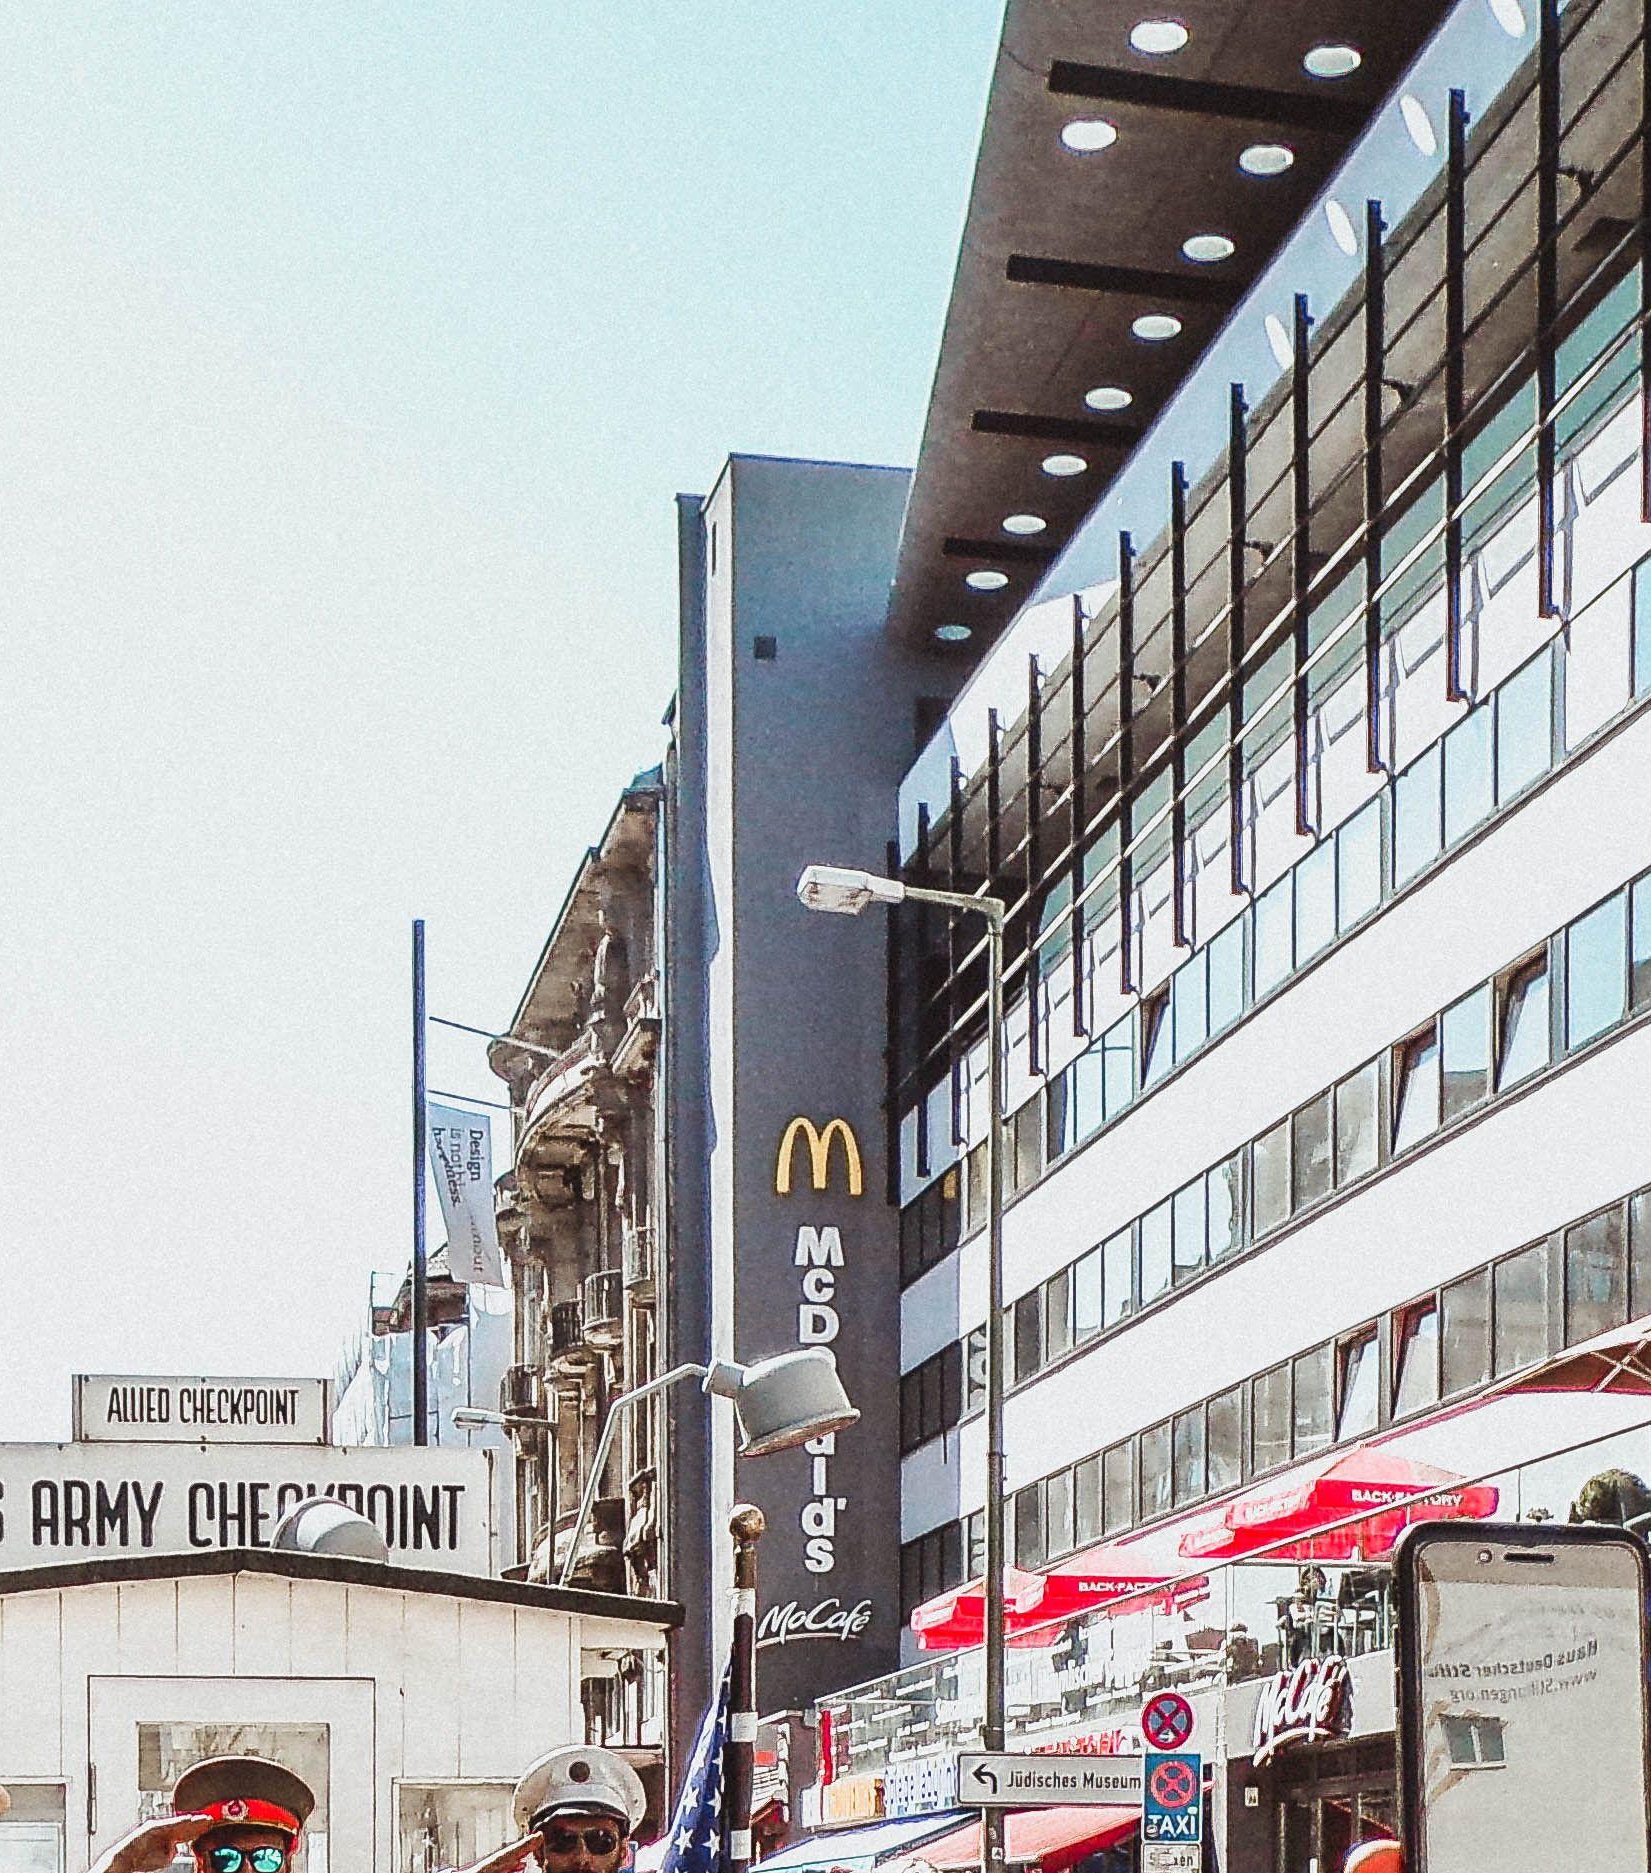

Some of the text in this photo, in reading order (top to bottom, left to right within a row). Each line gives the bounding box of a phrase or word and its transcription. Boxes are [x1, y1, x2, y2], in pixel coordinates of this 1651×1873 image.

[467, 1128, 485, 1182] Design
[107, 1387, 299, 1427] ALLIED CHECKPOINT
[794, 1225, 848, 1573] McDald's
[31, 1479, 165, 1549] ARMY
[1007, 1769, 1141, 1789] Jüdisches Museum
[1148, 1812, 1197, 1836] TAXI
